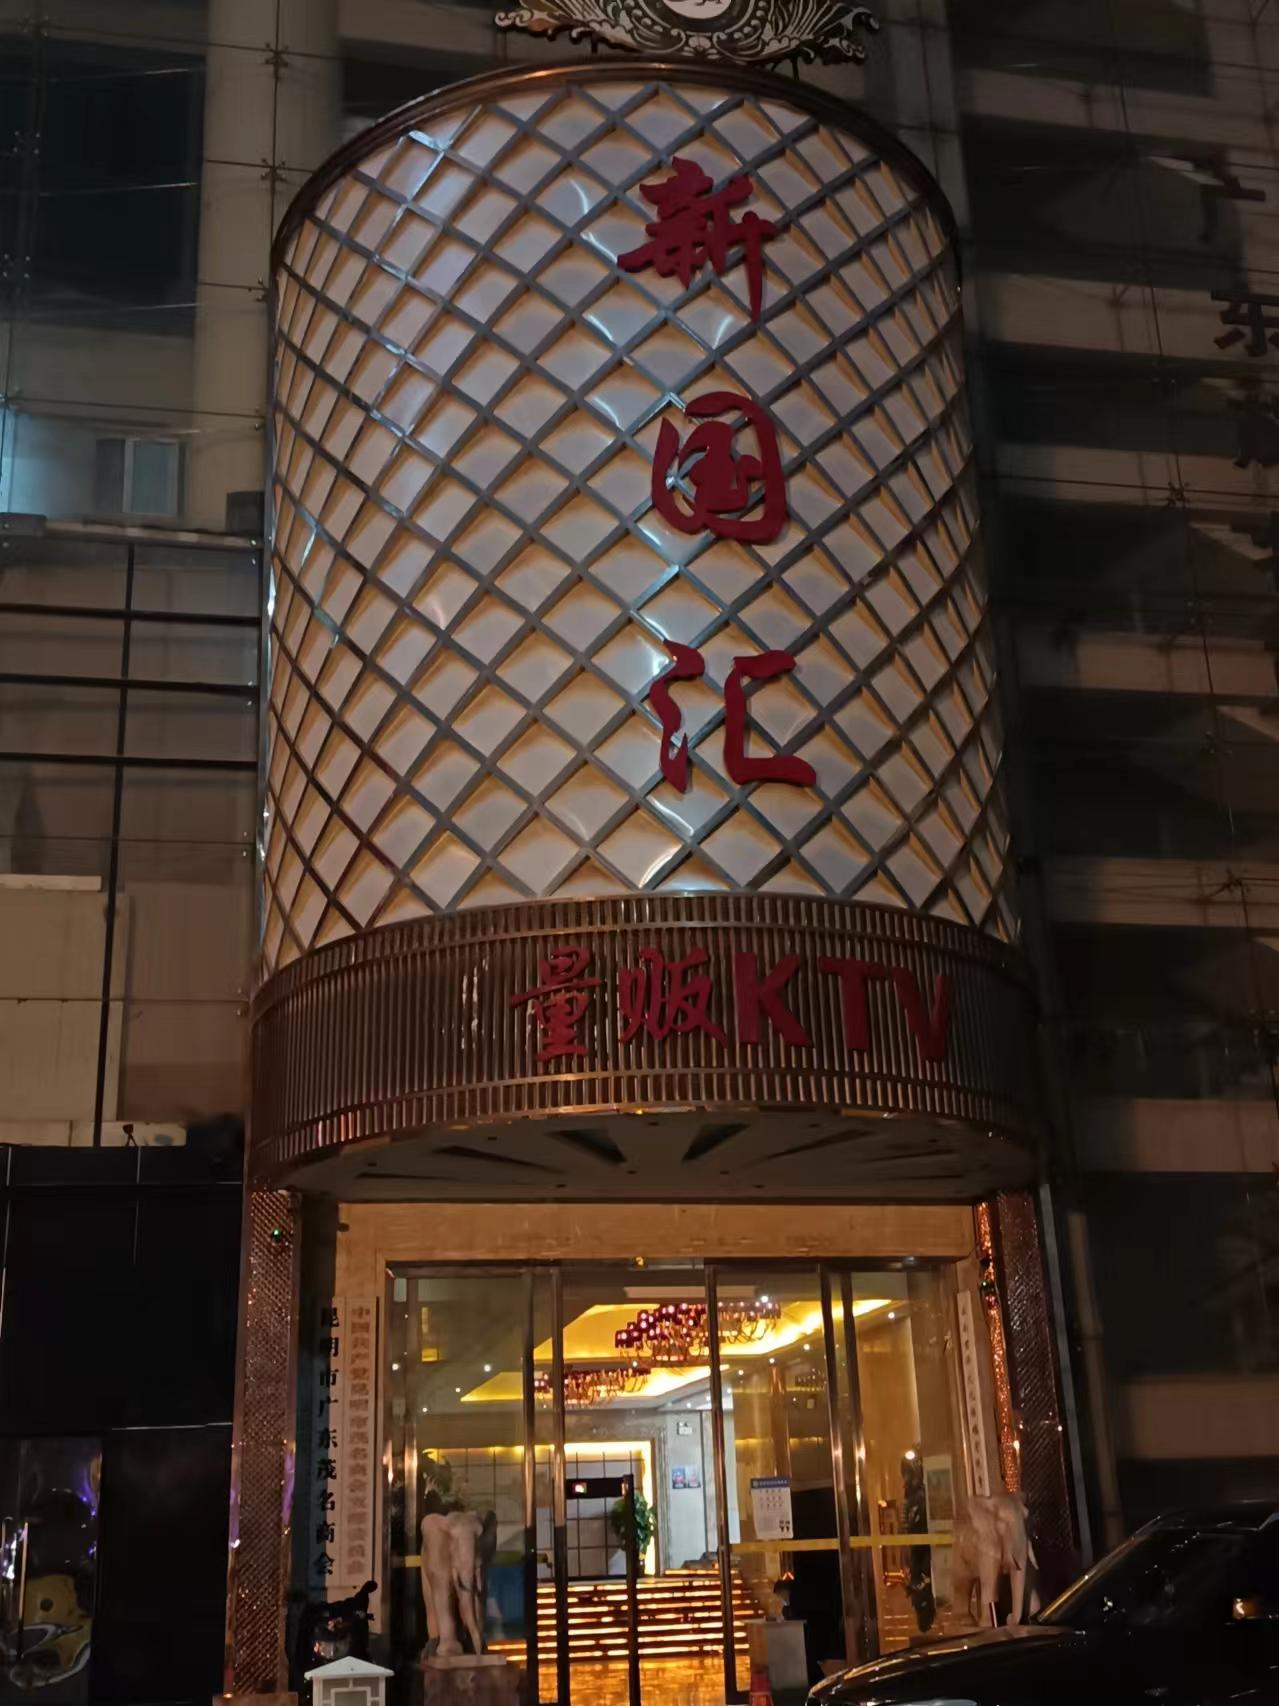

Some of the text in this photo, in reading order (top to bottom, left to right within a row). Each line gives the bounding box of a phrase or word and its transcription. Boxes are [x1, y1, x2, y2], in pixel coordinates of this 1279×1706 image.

[617, 155, 815, 793] 新国汇
[510, 944, 953, 1063] 量贩KTV
[315, 1307, 340, 1576] 昆明市广东茂名商会
